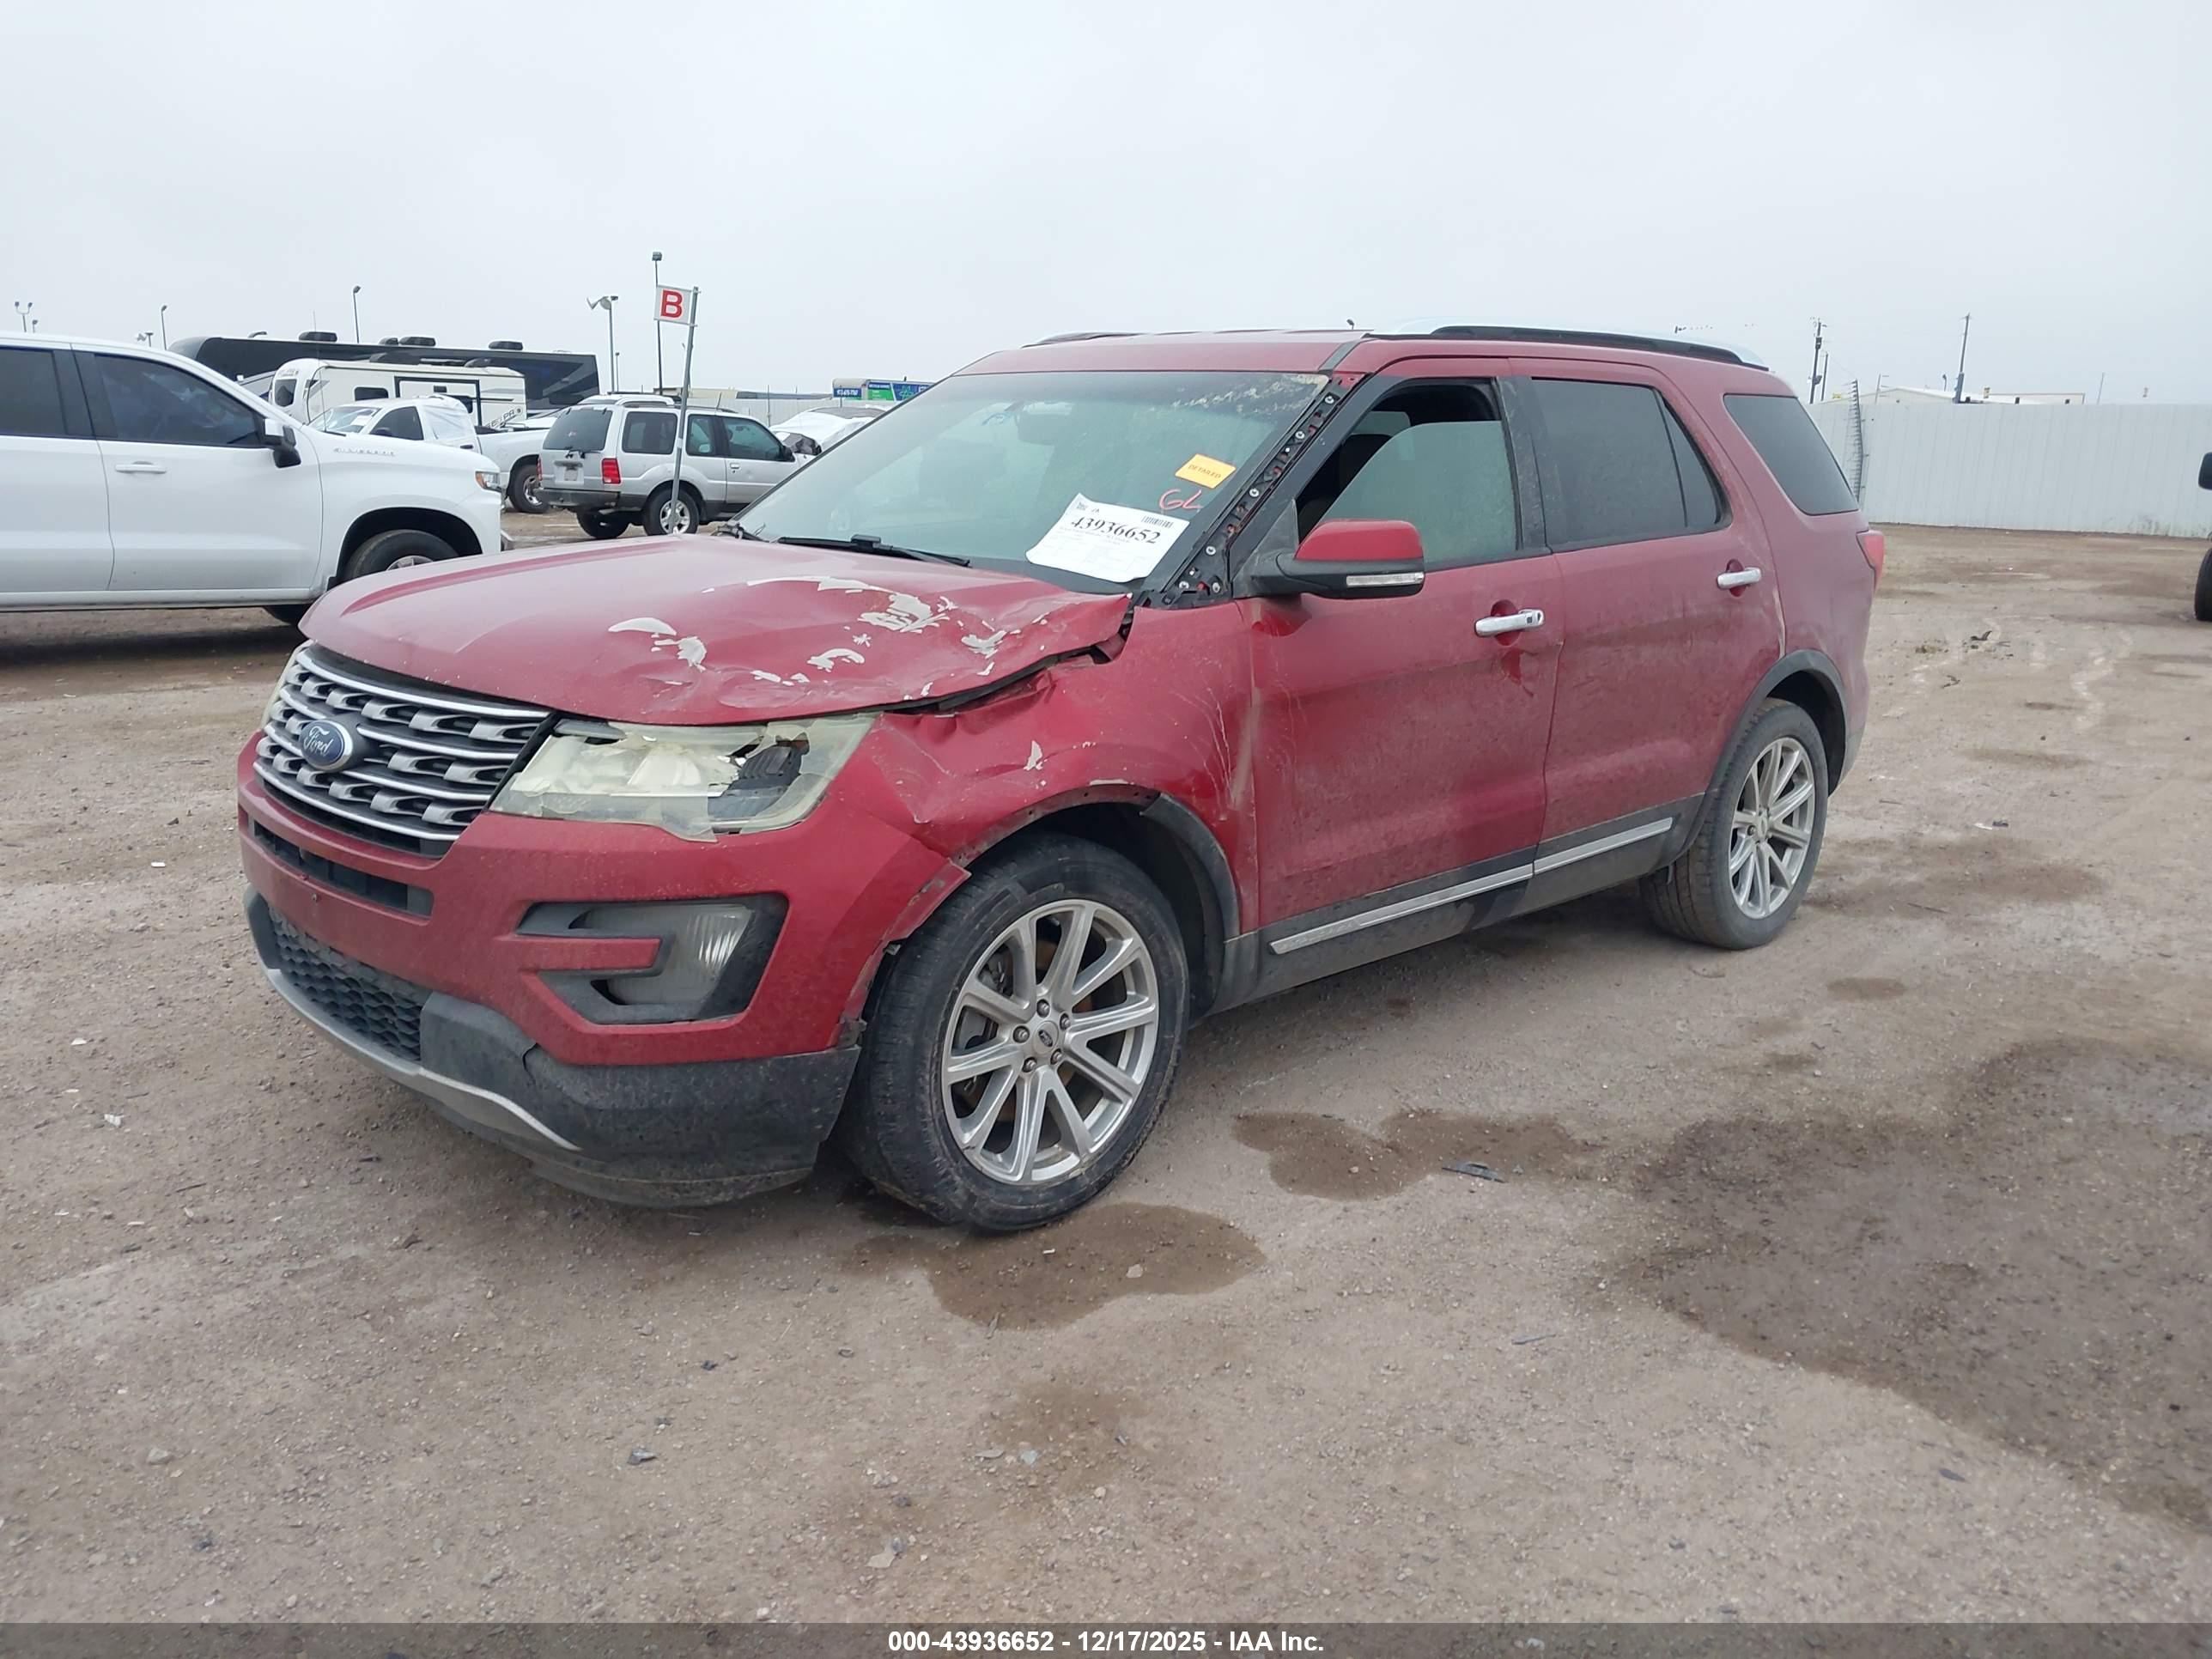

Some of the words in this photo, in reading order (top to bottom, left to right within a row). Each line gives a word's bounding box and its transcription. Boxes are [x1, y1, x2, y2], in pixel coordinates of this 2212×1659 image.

[660, 289, 684, 319] B
[1071, 516, 1161, 544] 43936652
[303, 726, 334, 757] Ford
